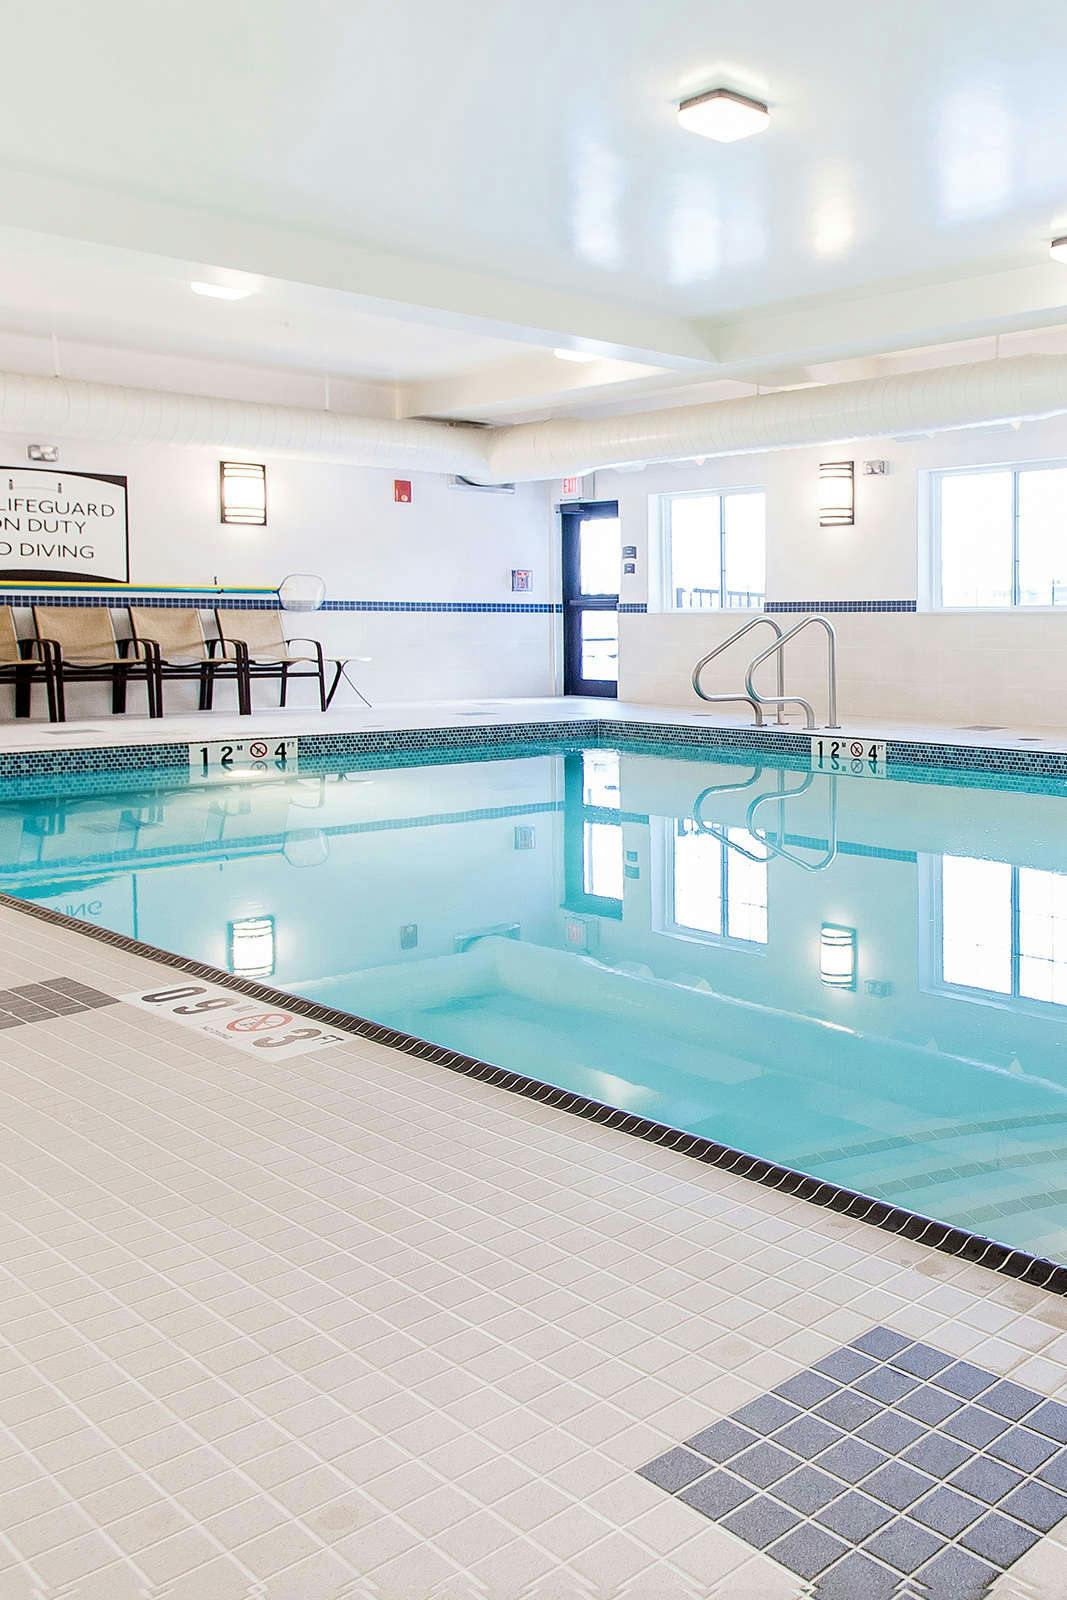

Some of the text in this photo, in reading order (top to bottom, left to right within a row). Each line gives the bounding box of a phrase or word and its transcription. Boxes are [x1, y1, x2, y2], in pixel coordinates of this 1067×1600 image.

[563, 477, 577, 494] EXIT
[0, 517, 86, 534] N DUTY
[20, 543, 94, 559] DIVING
[252, 1028, 322, 1048] 3
